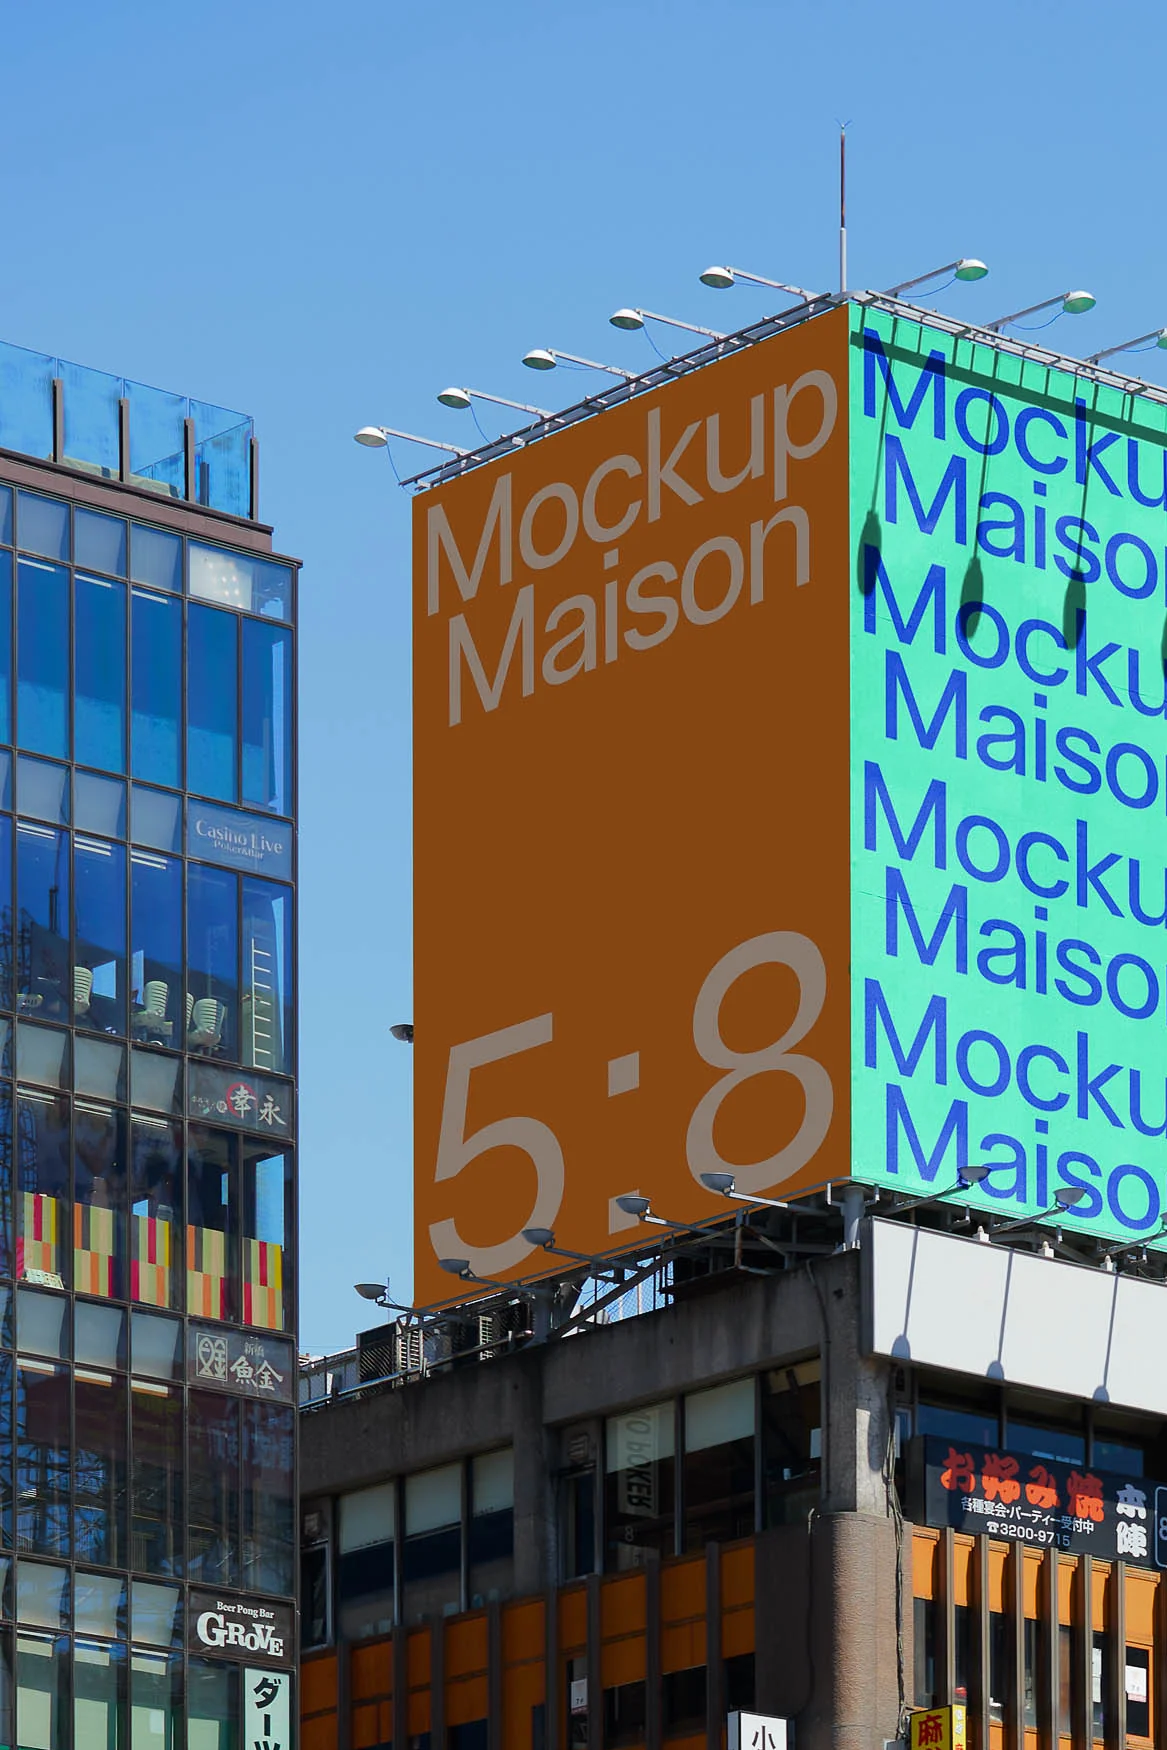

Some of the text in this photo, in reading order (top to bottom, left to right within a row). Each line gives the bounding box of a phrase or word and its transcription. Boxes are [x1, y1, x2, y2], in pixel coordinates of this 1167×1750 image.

[427, 368, 837, 615] Mockup
[448, 505, 811, 726] Maison
[196, 819, 283, 854] Casino Live
[230, 1085, 287, 1126] 幸永
[230, 1355, 284, 1391] 魚金
[940, 1447, 1105, 1523] お好み焼
[1000, 1521, 1071, 1547] 3200-9715
[1115, 1483, 1148, 1558] 本陣
[216, 1601, 275, 1619] Beer Pong Bar
[196, 1611, 284, 1657] GROVE
